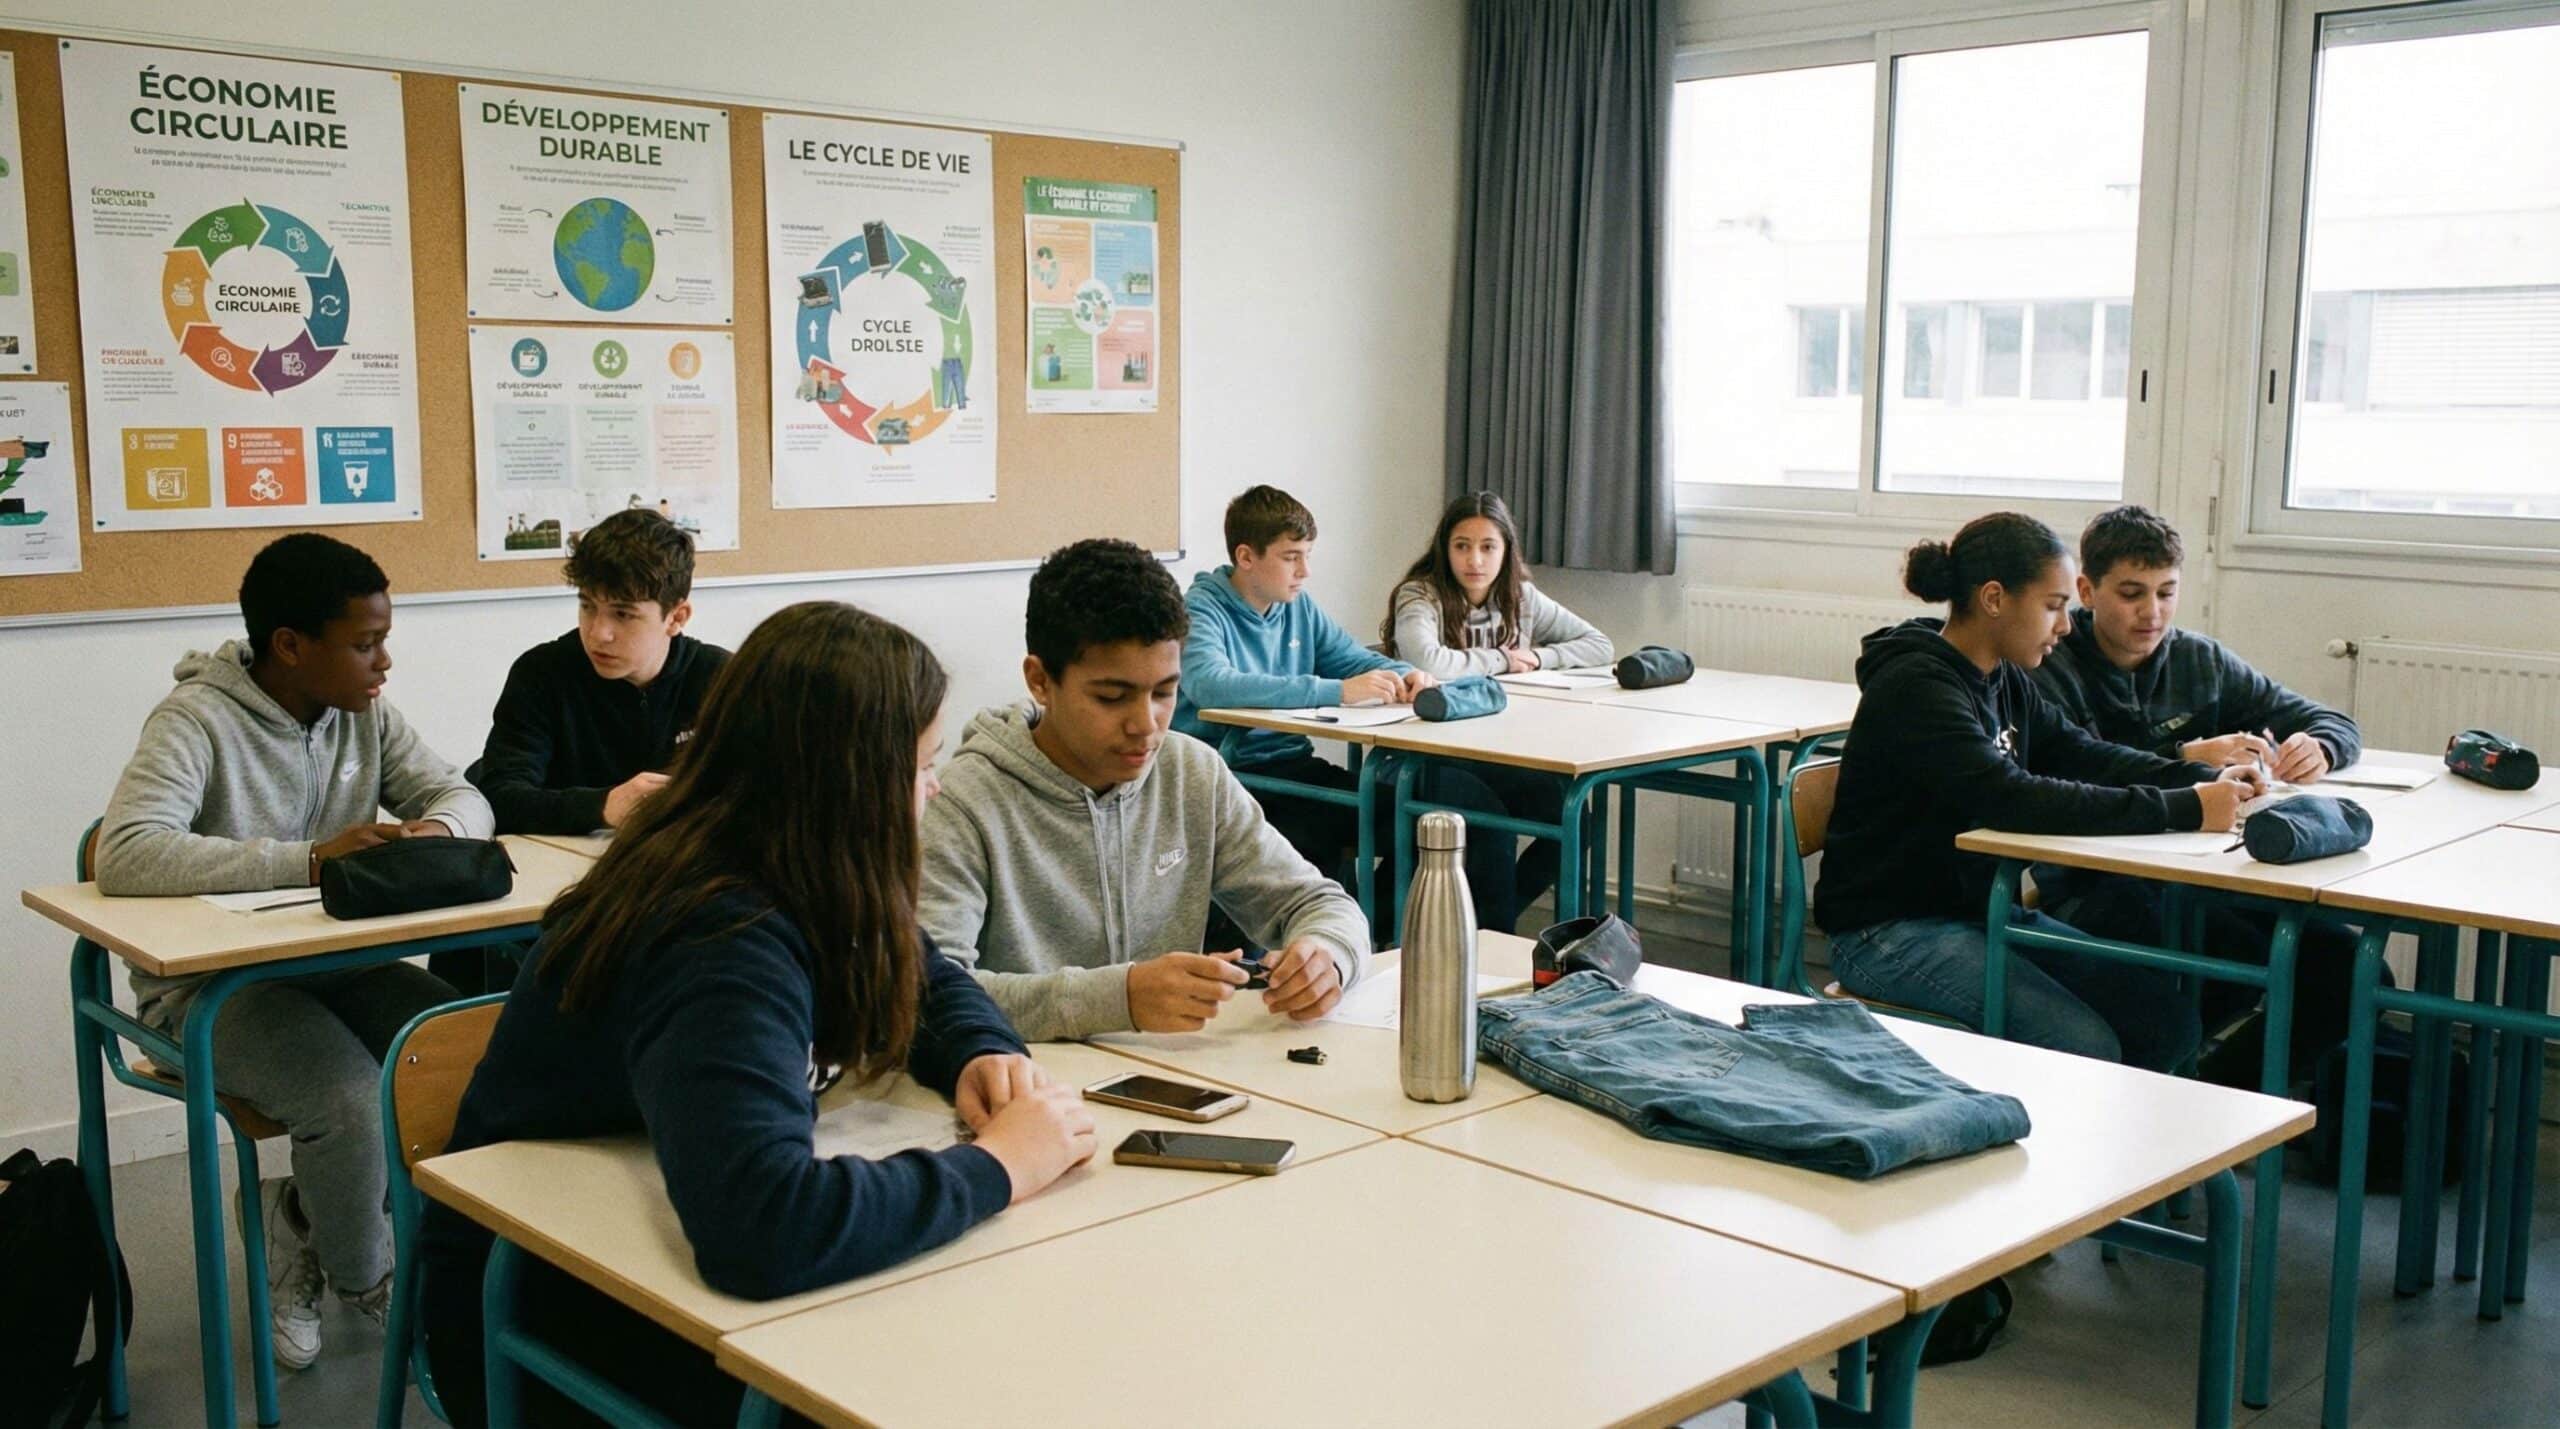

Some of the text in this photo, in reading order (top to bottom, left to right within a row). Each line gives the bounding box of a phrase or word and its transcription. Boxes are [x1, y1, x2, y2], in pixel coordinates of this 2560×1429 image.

[138, 64, 337, 115] ÉCONOMIE
[129, 106, 349, 150] CIRCULAIRE
[481, 99, 711, 143] DÉVELOPPEMENT
[539, 136, 663, 166] DURABLE
[789, 139, 971, 174] LE CYCLE DE VIE
[219, 284, 297, 298] ECONOMIE
[215, 300, 301, 313] CIRCULAIRE
[863, 319, 912, 333] CYCLE
[851, 338, 923, 353] DROLSIE
[228, 433, 237, 449] 9
